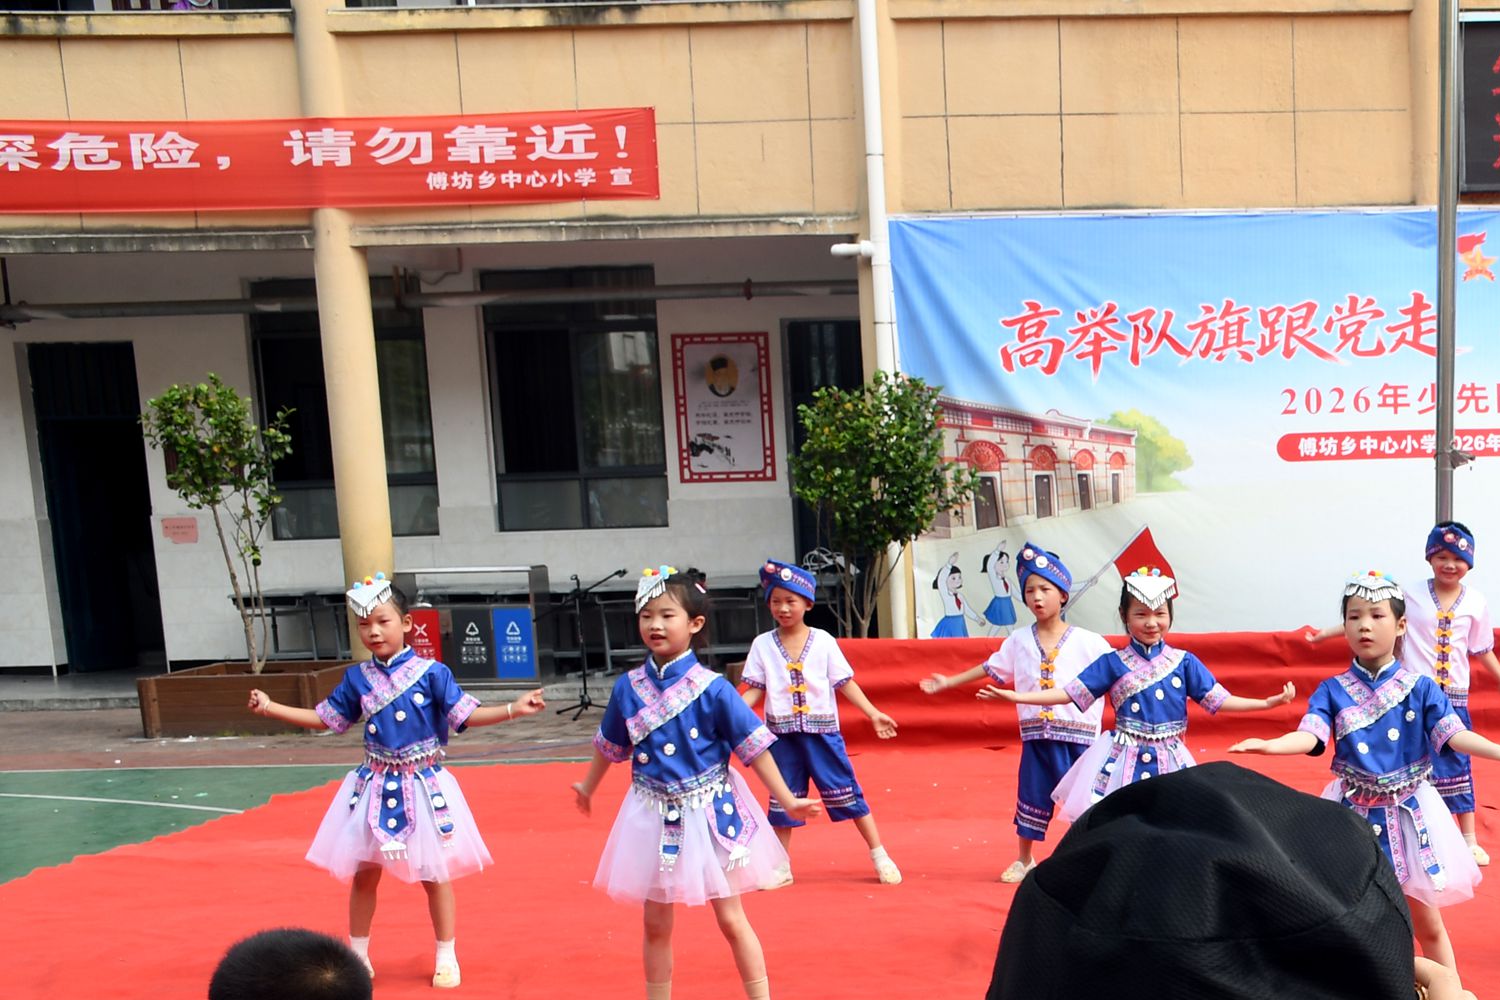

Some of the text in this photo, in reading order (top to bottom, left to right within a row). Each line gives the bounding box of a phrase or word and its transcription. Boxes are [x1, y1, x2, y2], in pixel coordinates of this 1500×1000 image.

[426, 166, 633, 191] 傅坊乡中心小学 宣
[1000, 291, 1440, 382] 高举队旗跟党走
